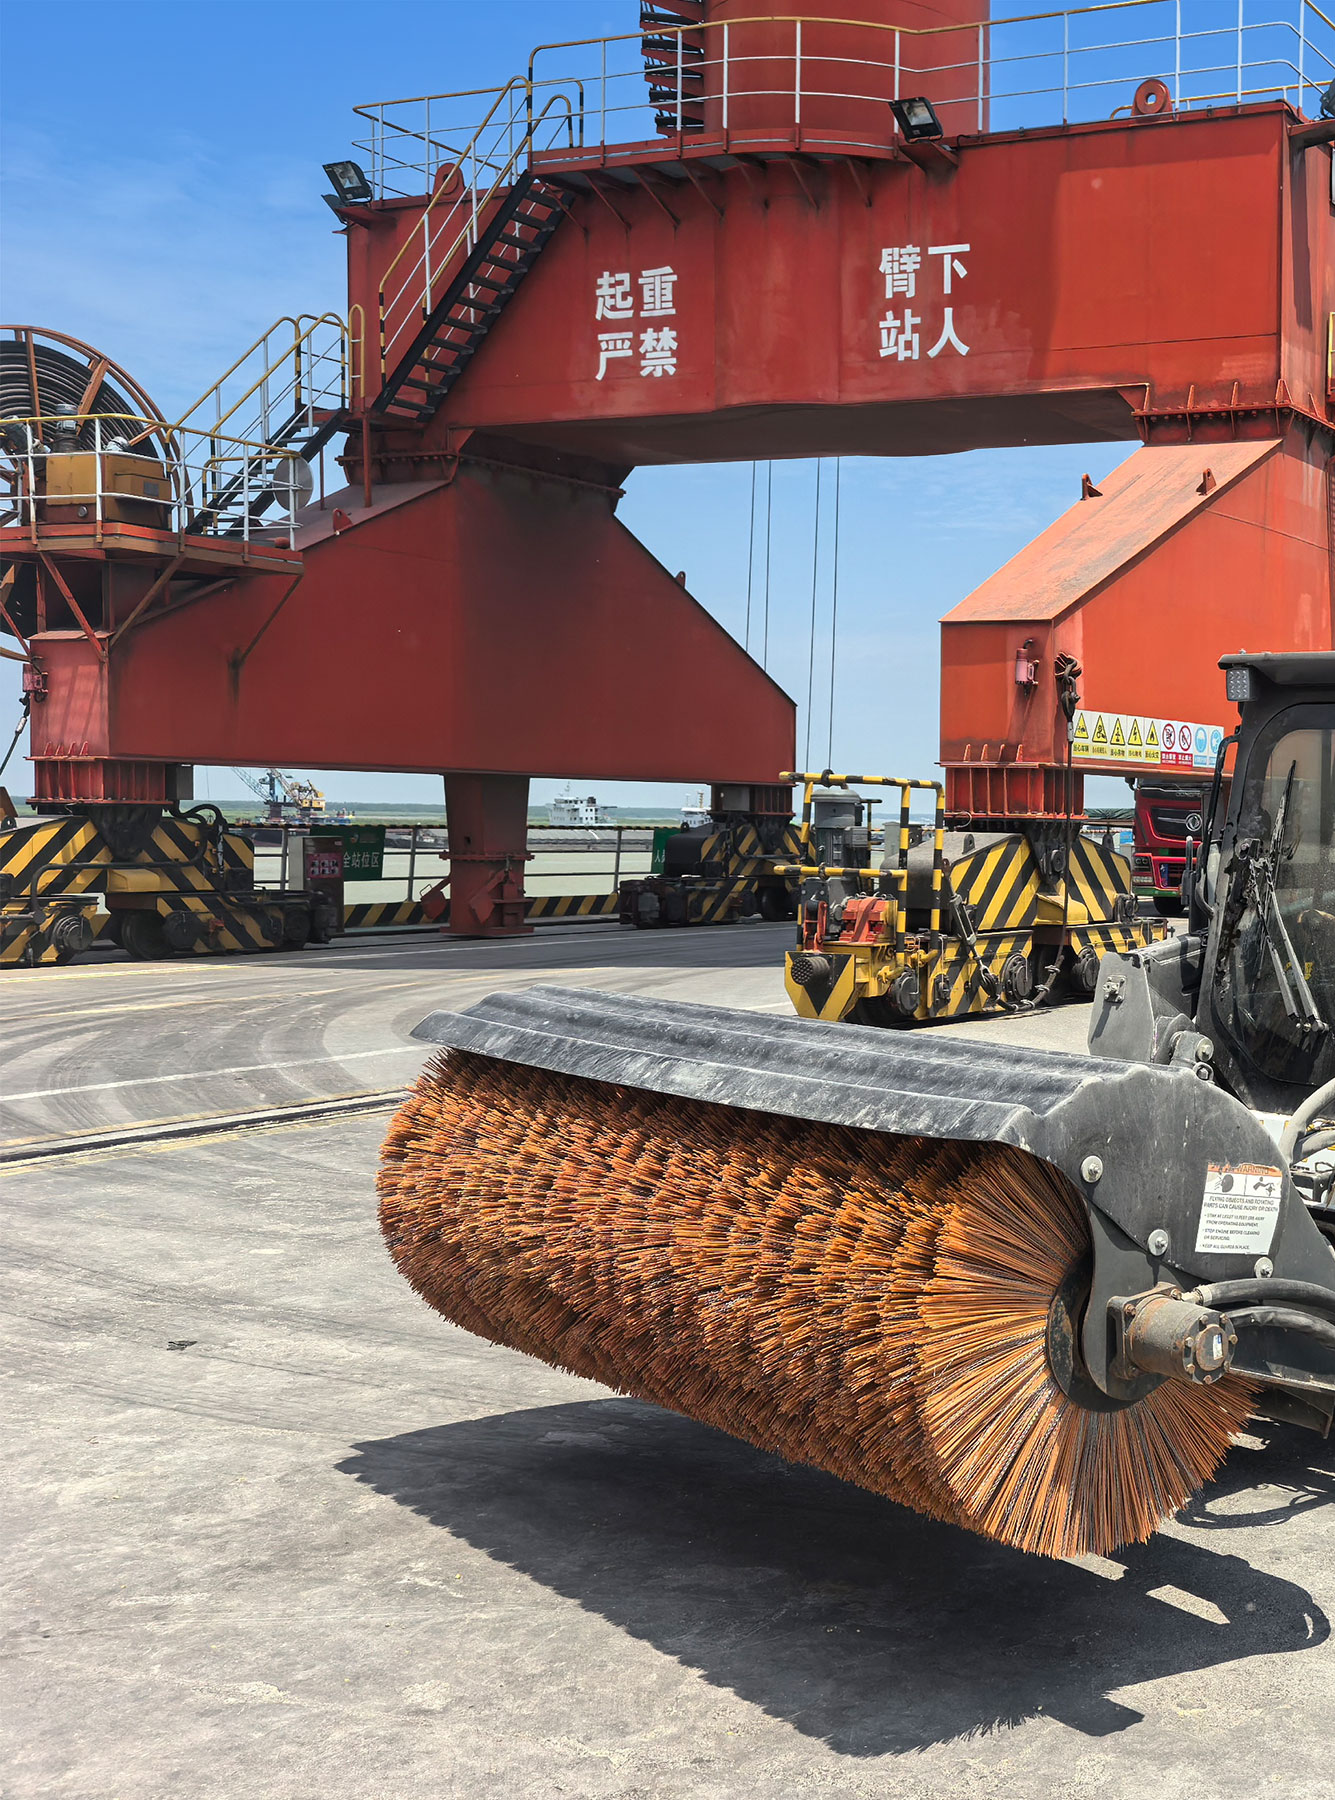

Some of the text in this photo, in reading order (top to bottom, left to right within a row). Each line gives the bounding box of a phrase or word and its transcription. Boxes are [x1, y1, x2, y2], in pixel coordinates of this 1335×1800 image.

[595, 243, 971, 321] 起重 臂下
[595, 306, 971, 381] 严禁 站人
